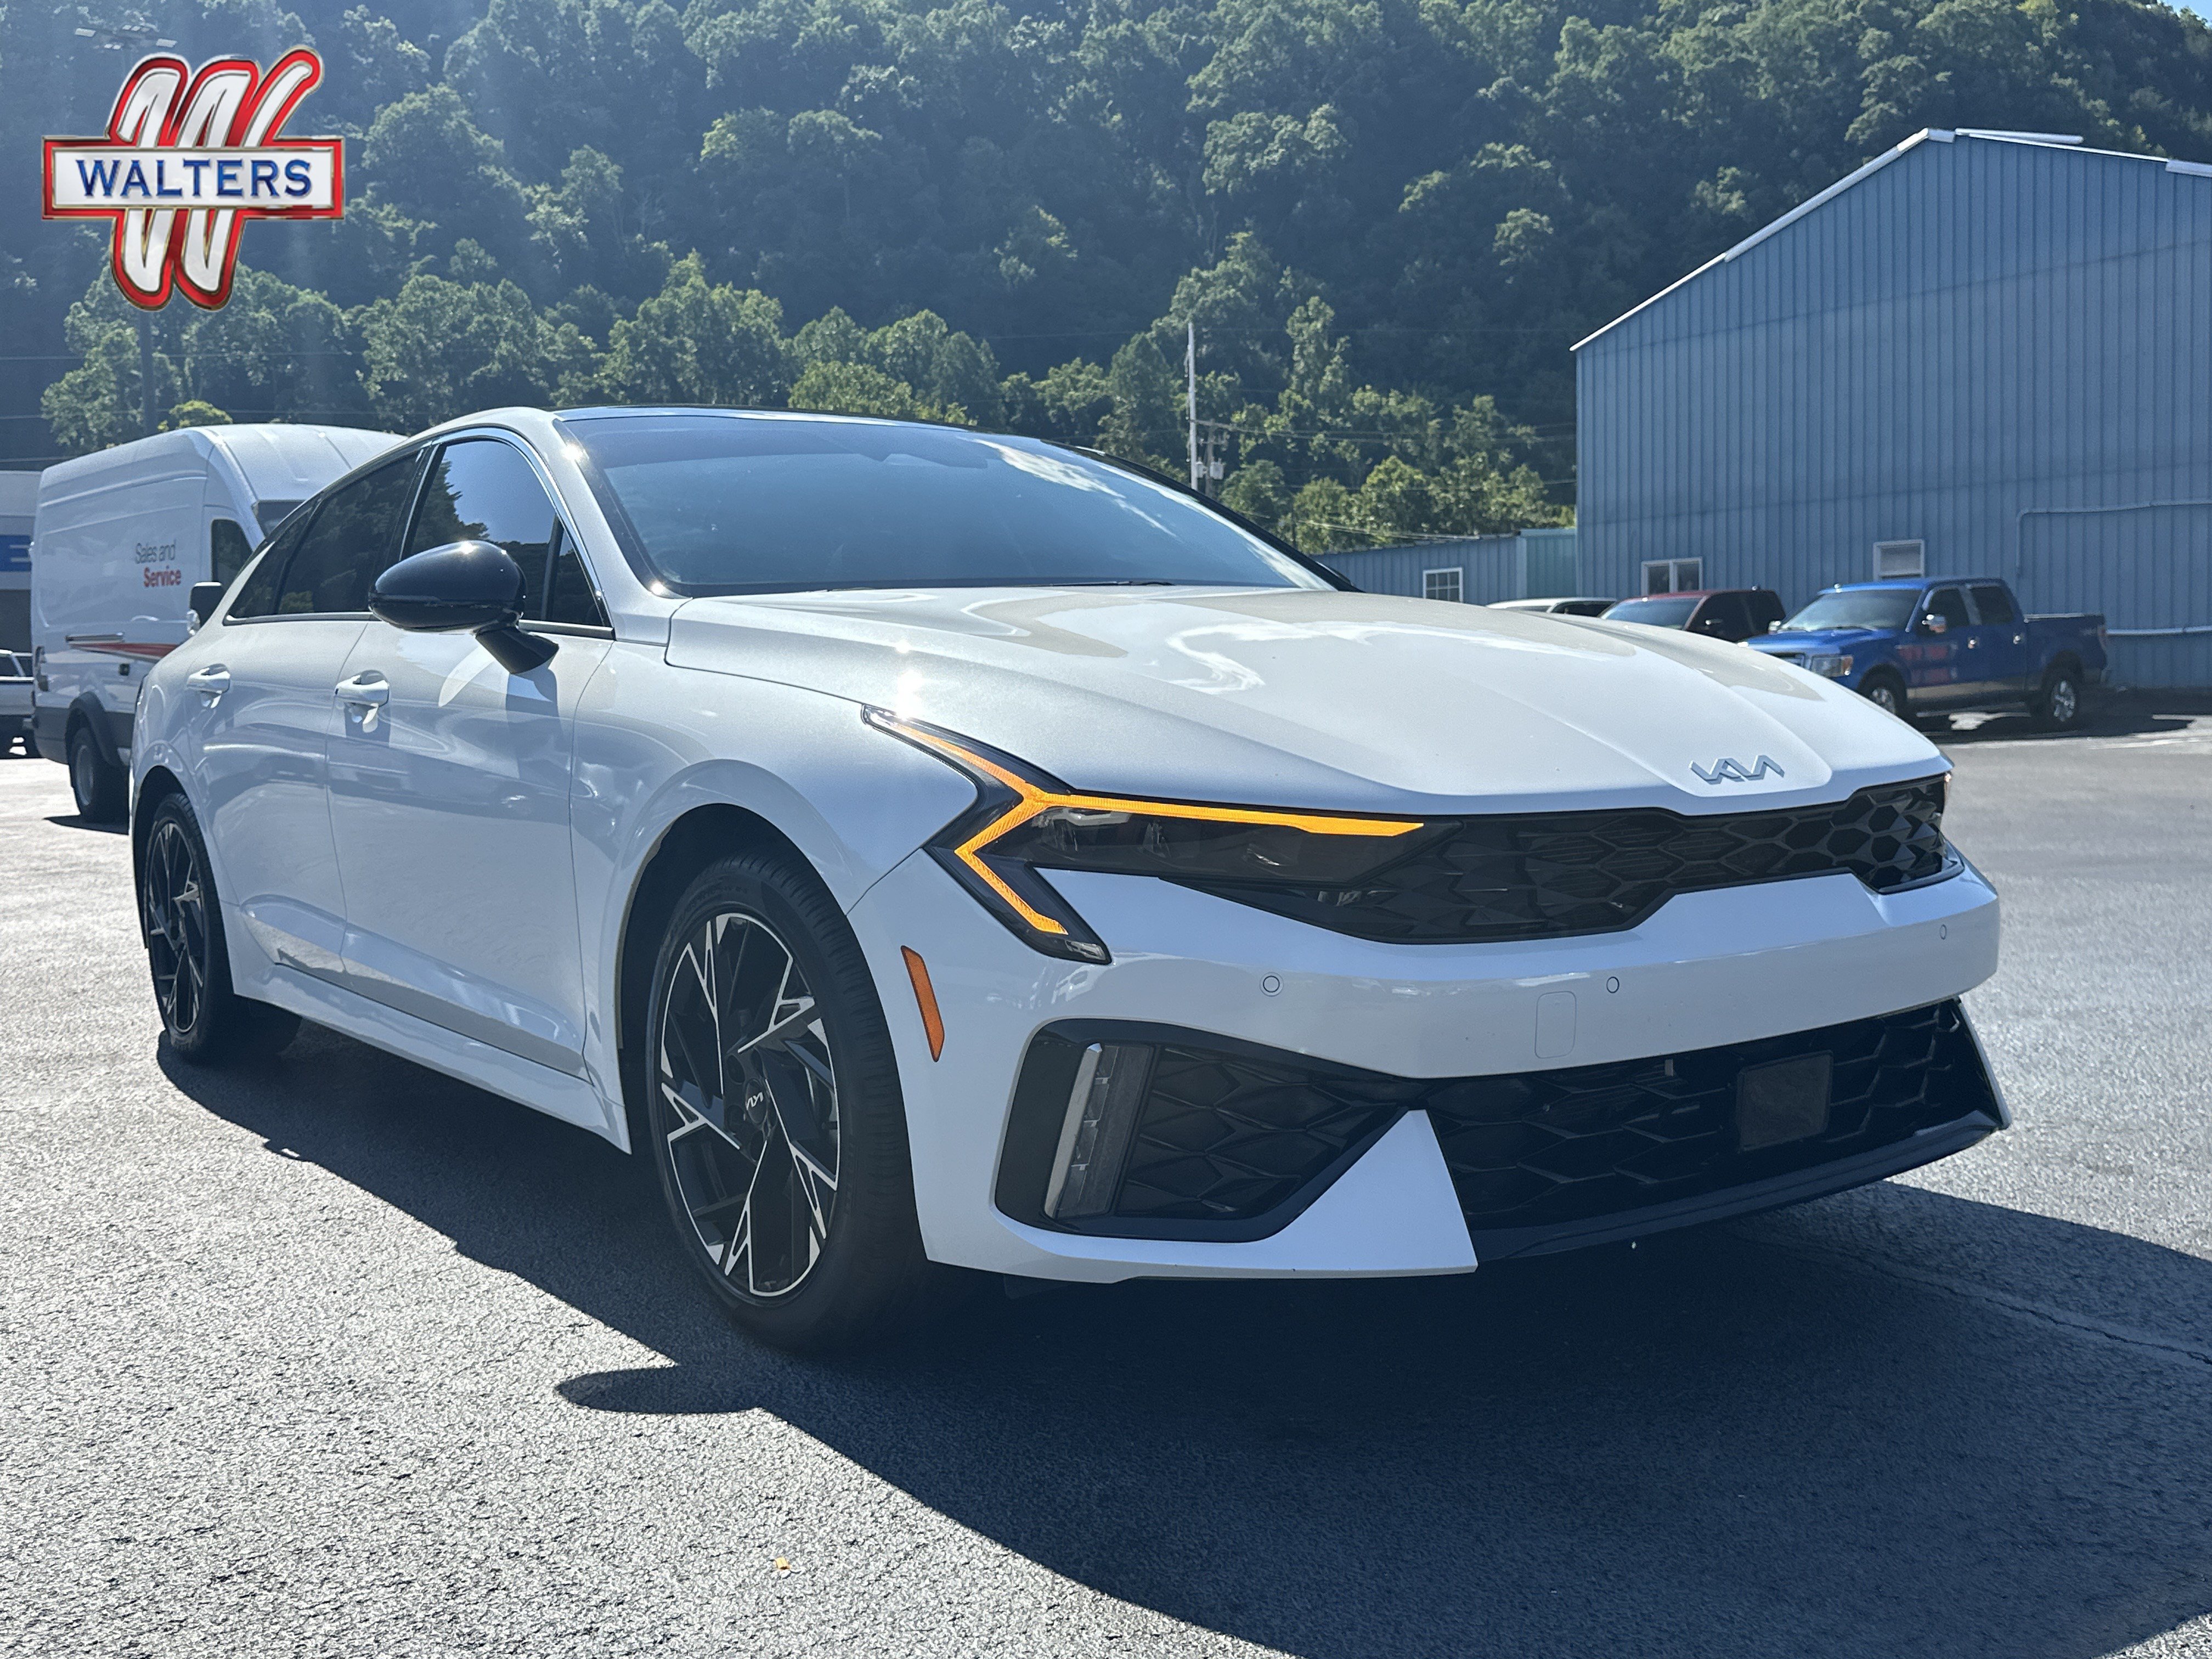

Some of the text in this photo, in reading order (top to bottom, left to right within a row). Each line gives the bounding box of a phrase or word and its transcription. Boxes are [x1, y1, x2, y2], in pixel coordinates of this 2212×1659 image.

[135, 539, 176, 565] Sales and
[143, 565, 182, 588] Service
